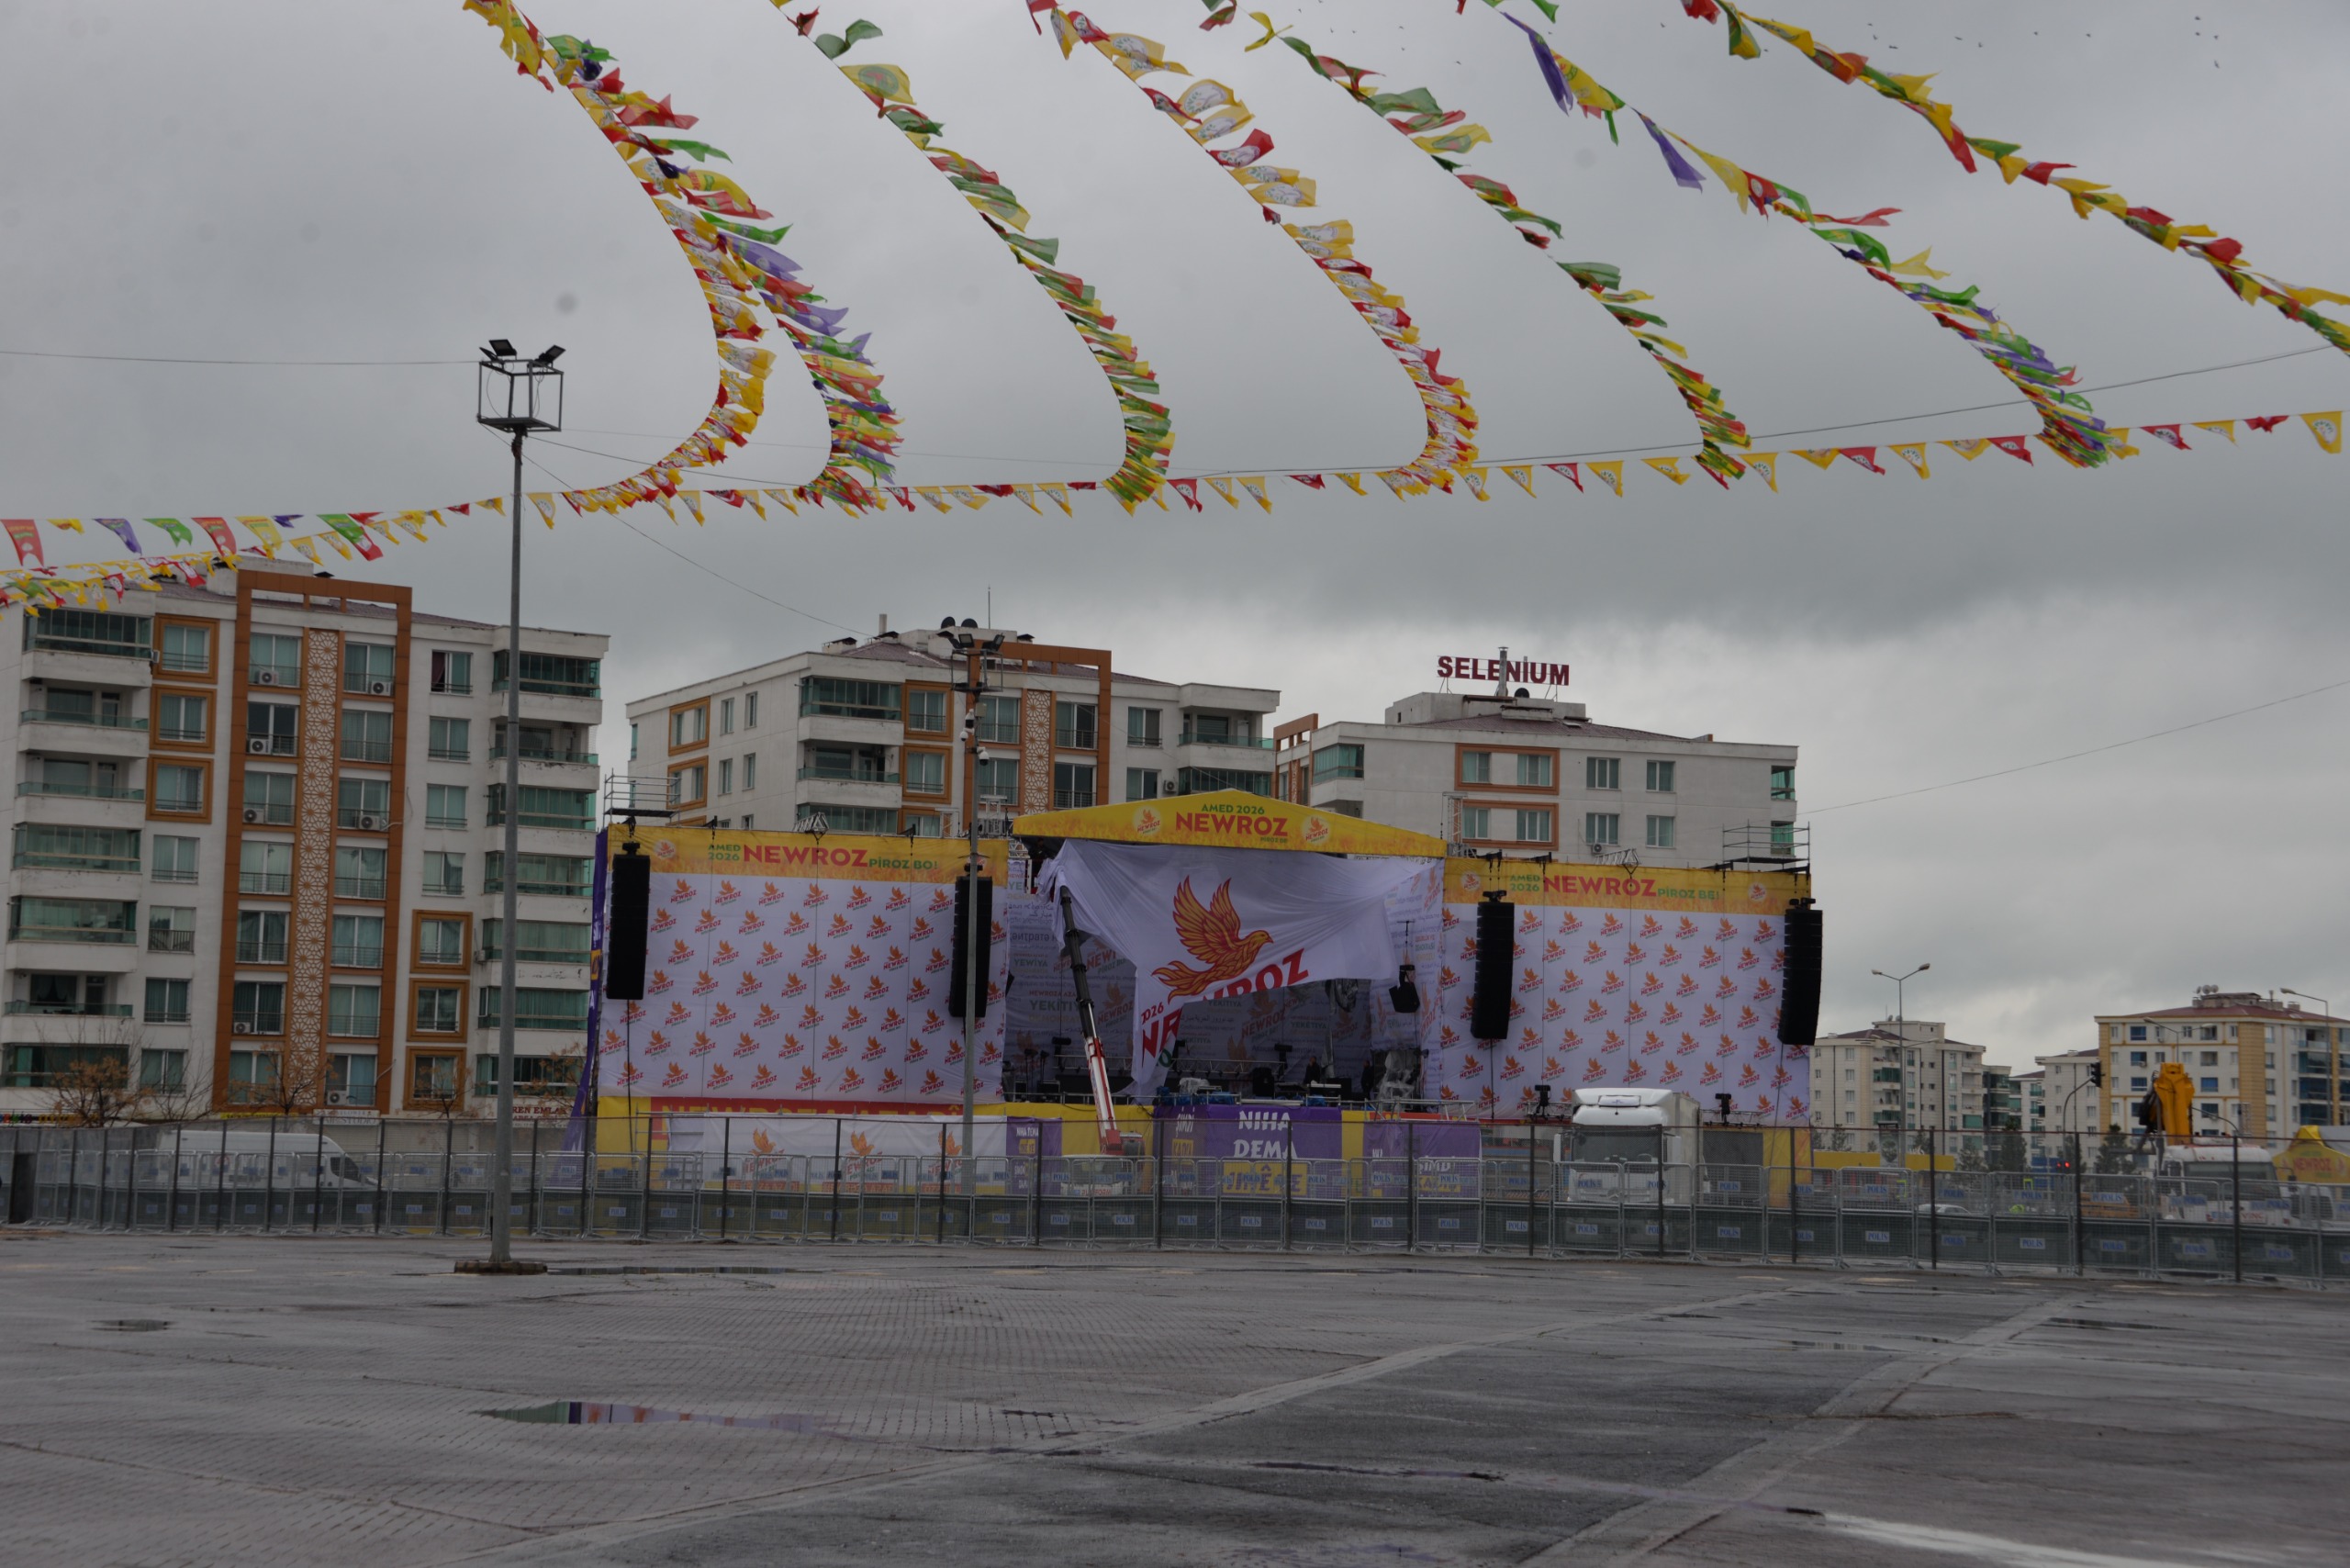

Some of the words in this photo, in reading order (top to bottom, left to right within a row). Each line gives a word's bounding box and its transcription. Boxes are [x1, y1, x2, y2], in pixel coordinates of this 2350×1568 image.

[1202, 804, 1234, 812] AMED
[1237, 805, 1265, 814] 2026
[1136, 820, 1161, 832] NEWROZ
[1175, 812, 1288, 836] NEWROZ
[1305, 828, 1328, 841] NEWROZ
[708, 844, 741, 852] AMED
[744, 844, 868, 868] NEWROZ
[913, 860, 938, 869] BO!
[708, 852, 740, 861] 2026
[1510, 874, 1540, 882] AMED
[1544, 875, 1657, 897] NEWROZ
[1510, 882, 1539, 891] 2026
[670, 889, 696, 902] NEWROZ
[759, 892, 785, 905] NEWROZ
[847, 896, 873, 909] NEWROZ
[929, 898, 953, 911] NEWROZ
[650, 918, 676, 931] NEWROZ
[784, 922, 809, 935] NEWROZ
[827, 924, 853, 936] NEWROZ
[1519, 920, 1542, 933] NEWROZ
[1559, 920, 1583, 934] NEWROZ
[1601, 922, 1623, 935] NEWROZ
[1640, 924, 1662, 937] NEWROZ
[867, 925, 892, 938] NEWROZ
[911, 927, 934, 940] NEWROZ
[1755, 929, 1776, 942] NEWROZ
[756, 951, 783, 965] NEWROZ
[1542, 947, 1566, 961] NEWROZ
[1583, 949, 1607, 962] NEWROZ
[1660, 951, 1682, 965] NEWROZ
[844, 955, 870, 968] NEWROZ
[925, 958, 949, 971] NEWROZ
[1700, 955, 1721, 968] NEWROZ
[1738, 957, 1760, 969] NEWROZ
[736, 982, 763, 995] NEWROZ
[781, 982, 807, 996] NEWROZ
[825, 984, 850, 998] NEWROZ
[1520, 979, 1542, 991] NEWROZ
[1559, 979, 1583, 991] NEWROZ
[1601, 980, 1624, 993] NEWROZ
[1641, 982, 1664, 995] NEWROZ
[1677, 982, 1700, 995] NEWROZ
[864, 986, 889, 999] NEWROZ
[1753, 986, 1776, 999] NEWROZ
[665, 1012, 690, 1025] NEWROZ
[1542, 1006, 1566, 1020] NEWROZ
[1584, 1008, 1606, 1022] NEWROZ
[1660, 1010, 1683, 1024] NEWROZ
[754, 1014, 779, 1026] NEWROZ
[841, 1015, 867, 1028] NEWROZ
[922, 1019, 945, 1032] NEWROZ
[1242, 1010, 1285, 1039] NEWROZ
[1737, 1014, 1759, 1027] NEWROZ
[599, 1039, 626, 1053] NEWROZ
[645, 1041, 671, 1054] NEWROZ
[1519, 1037, 1542, 1050] NEWROZ
[1560, 1036, 1583, 1049] NEWROZ
[1601, 1039, 1625, 1052] NEWROZ
[1641, 1041, 1664, 1054] NEWROZ
[1677, 1041, 1699, 1054] NEWROZ
[733, 1043, 759, 1056] NEWROZ
[778, 1045, 804, 1058] NEWROZ
[822, 1047, 848, 1059] NEWROZ
[861, 1047, 886, 1060] NEWROZ
[904, 1048, 929, 1061] NEWROZ
[1718, 1043, 1738, 1057] NEWROZ
[1754, 1045, 1774, 1058] NEWROZ
[1460, 1065, 1483, 1078] NEWROZ
[1501, 1065, 1525, 1079] NEWROZ
[1542, 1065, 1564, 1079] NEWROZ
[1583, 1067, 1606, 1081] NEWROZ
[1660, 1069, 1682, 1082] NEWROZ
[751, 1074, 778, 1088] NEWROZ
[838, 1078, 865, 1092] NEWROZ
[1739, 1072, 1760, 1086] NEWROZ
[878, 1080, 902, 1092] NEWROZ
[920, 1081, 945, 1094] NEWROZ
[1238, 1110, 1292, 1131] NIHA
[1233, 1139, 1299, 1159] DEMA
